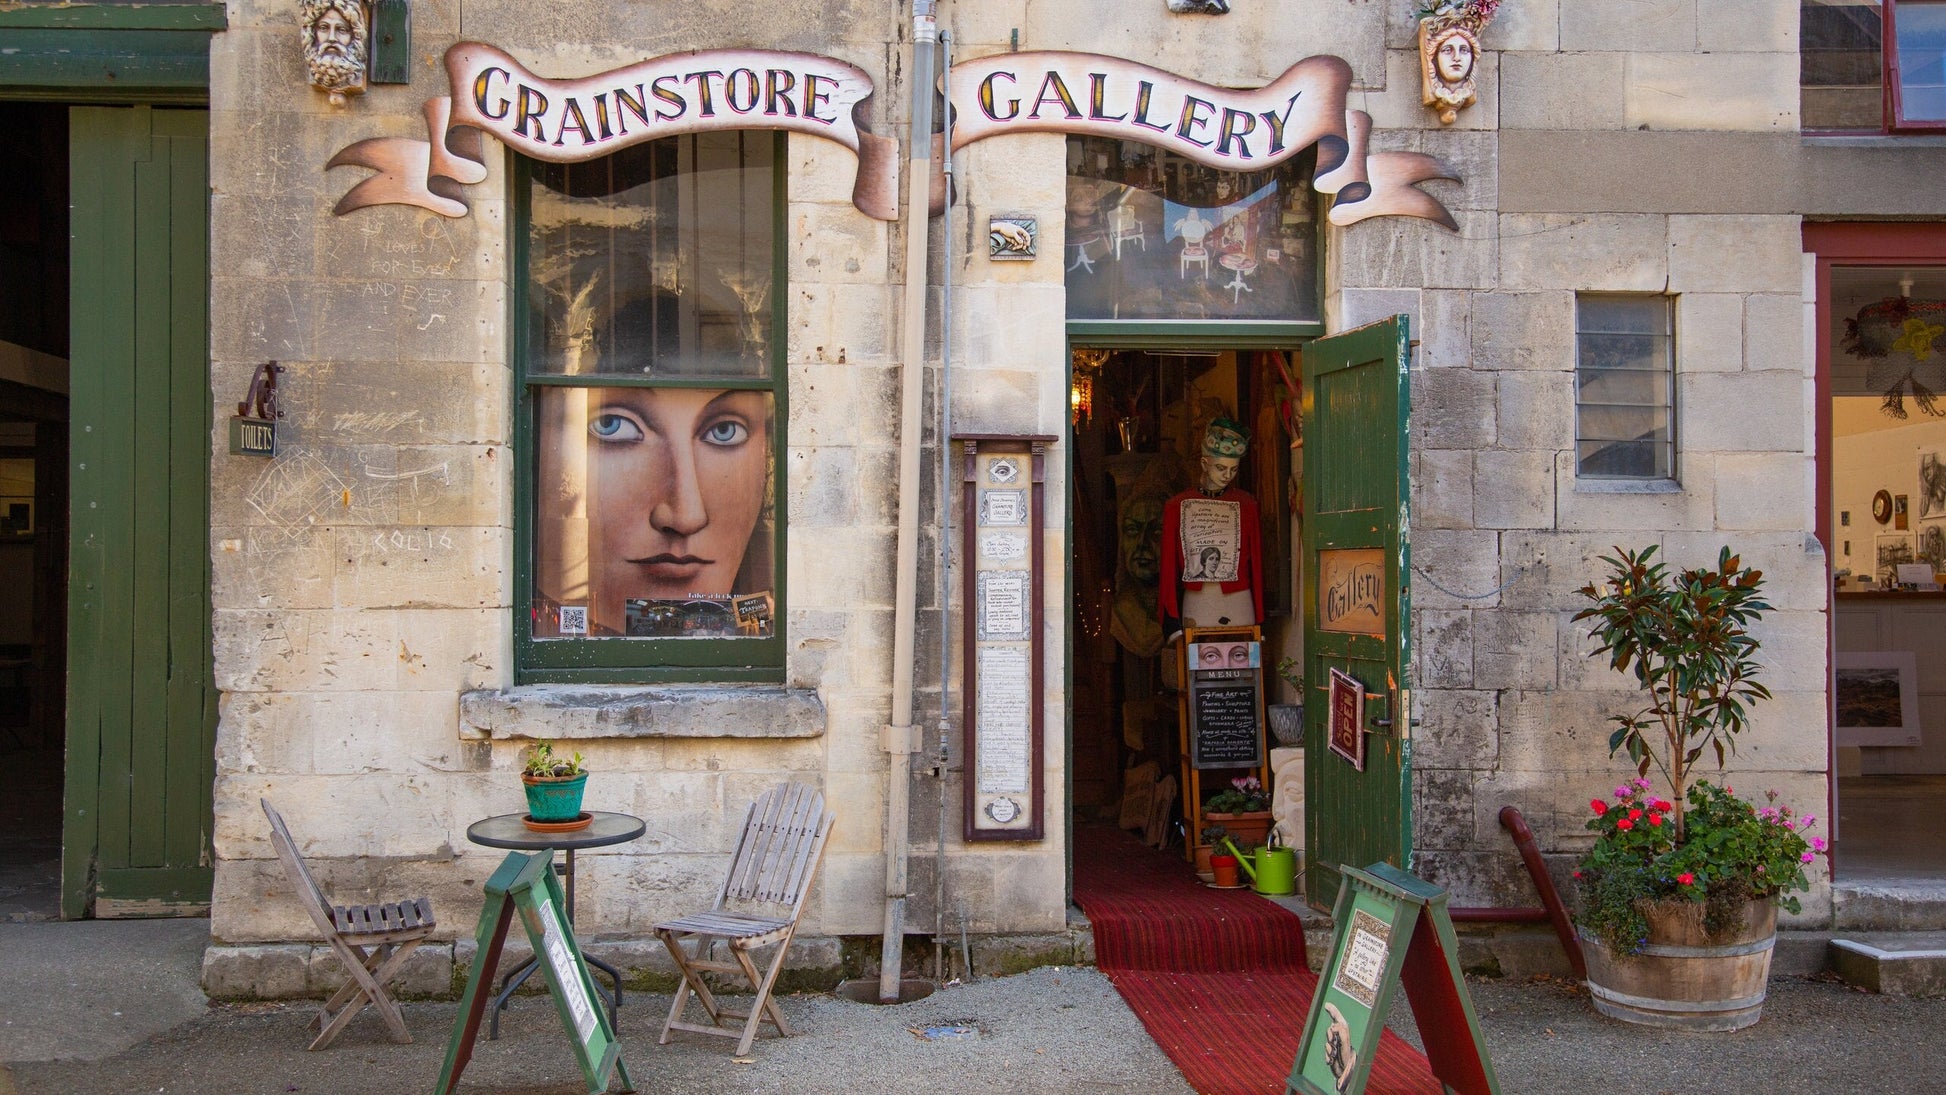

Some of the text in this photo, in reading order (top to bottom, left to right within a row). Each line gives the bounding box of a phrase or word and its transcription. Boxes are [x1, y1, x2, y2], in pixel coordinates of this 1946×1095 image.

[472, 67, 1302, 159] GRAINSTORE GALLERY
[363, 282, 396, 297] AND
[241, 424, 273, 450] TOILETS
[1327, 561, 1381, 623] Gallery
[1343, 692, 1354, 748] OPEN
